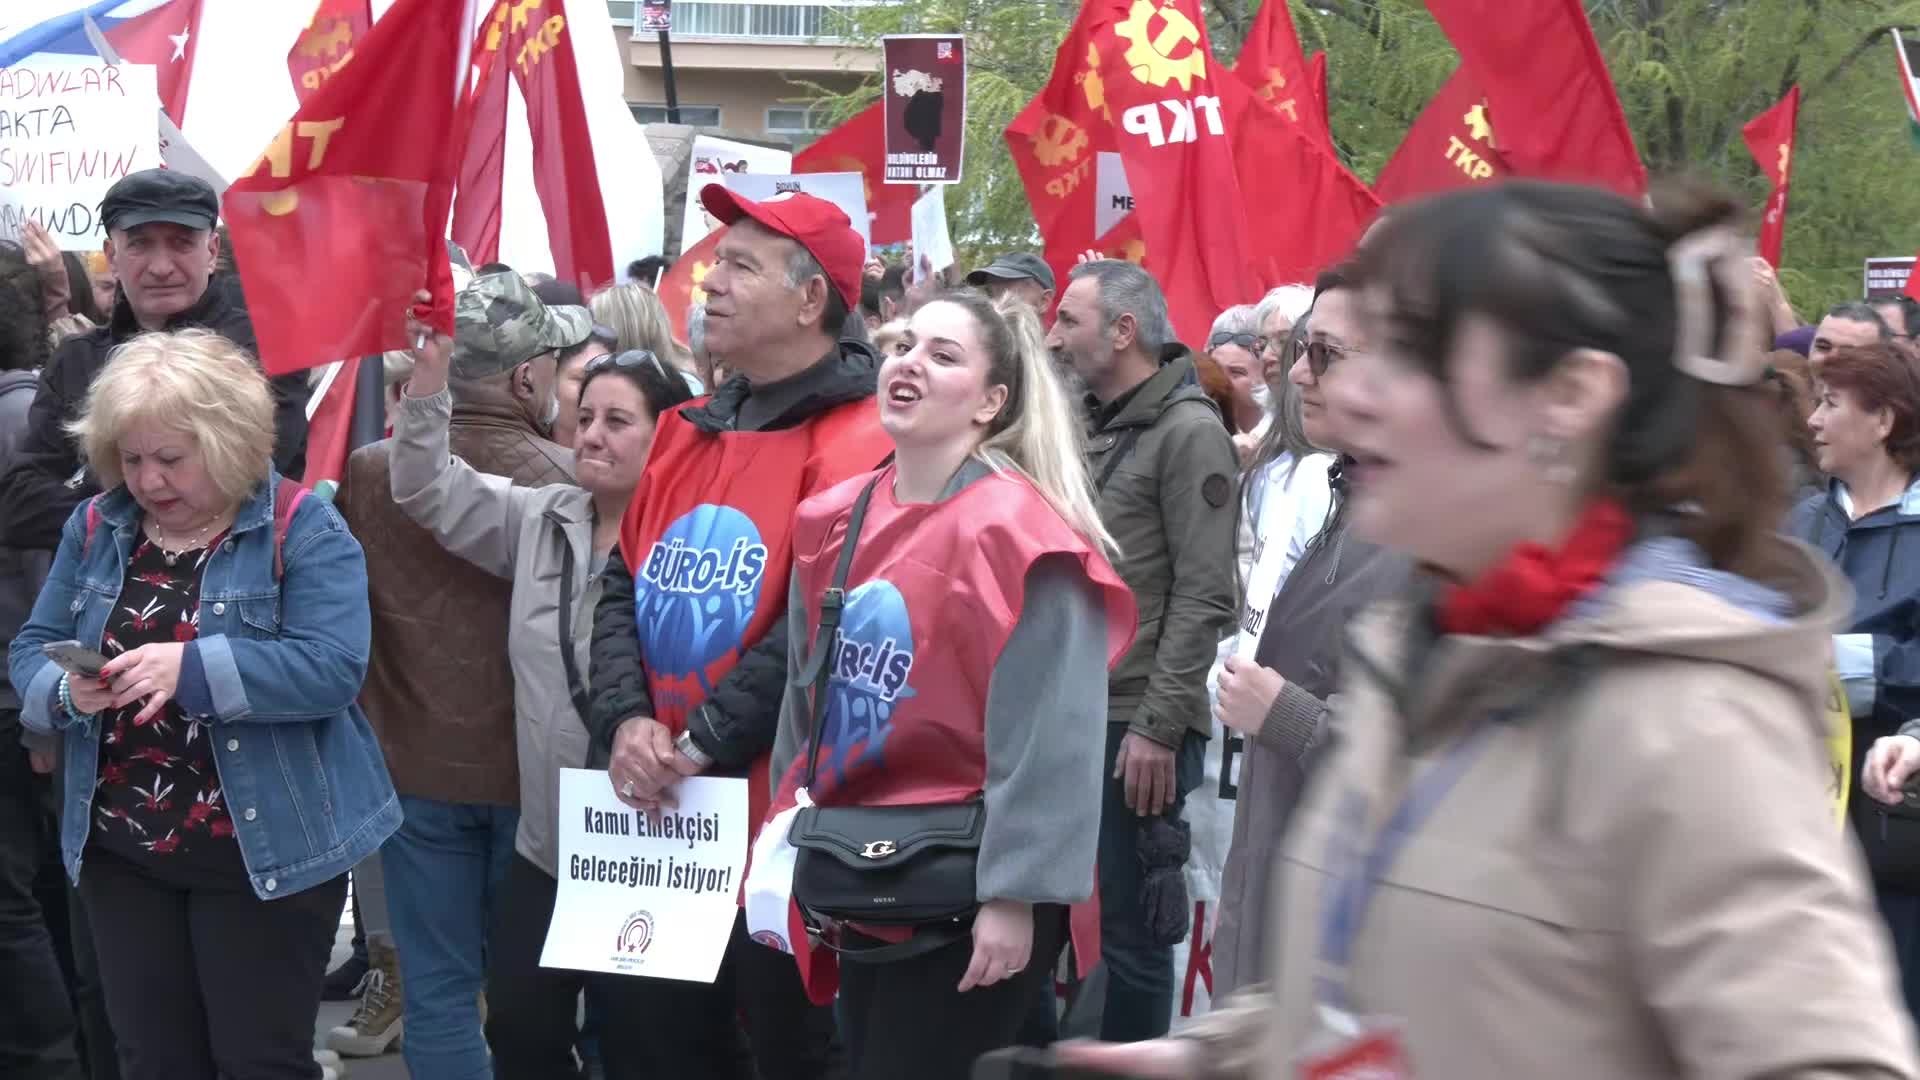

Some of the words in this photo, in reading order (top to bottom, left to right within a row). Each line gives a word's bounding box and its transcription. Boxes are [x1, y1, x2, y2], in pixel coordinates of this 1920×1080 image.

[1444, 135, 1493, 179] TKP
[643, 536, 767, 596] BÜRO-İŞ
[584, 806, 630, 836] Kamu
[570, 853, 662, 888] Geleceğini
[666, 855, 732, 894] İstiyor!
